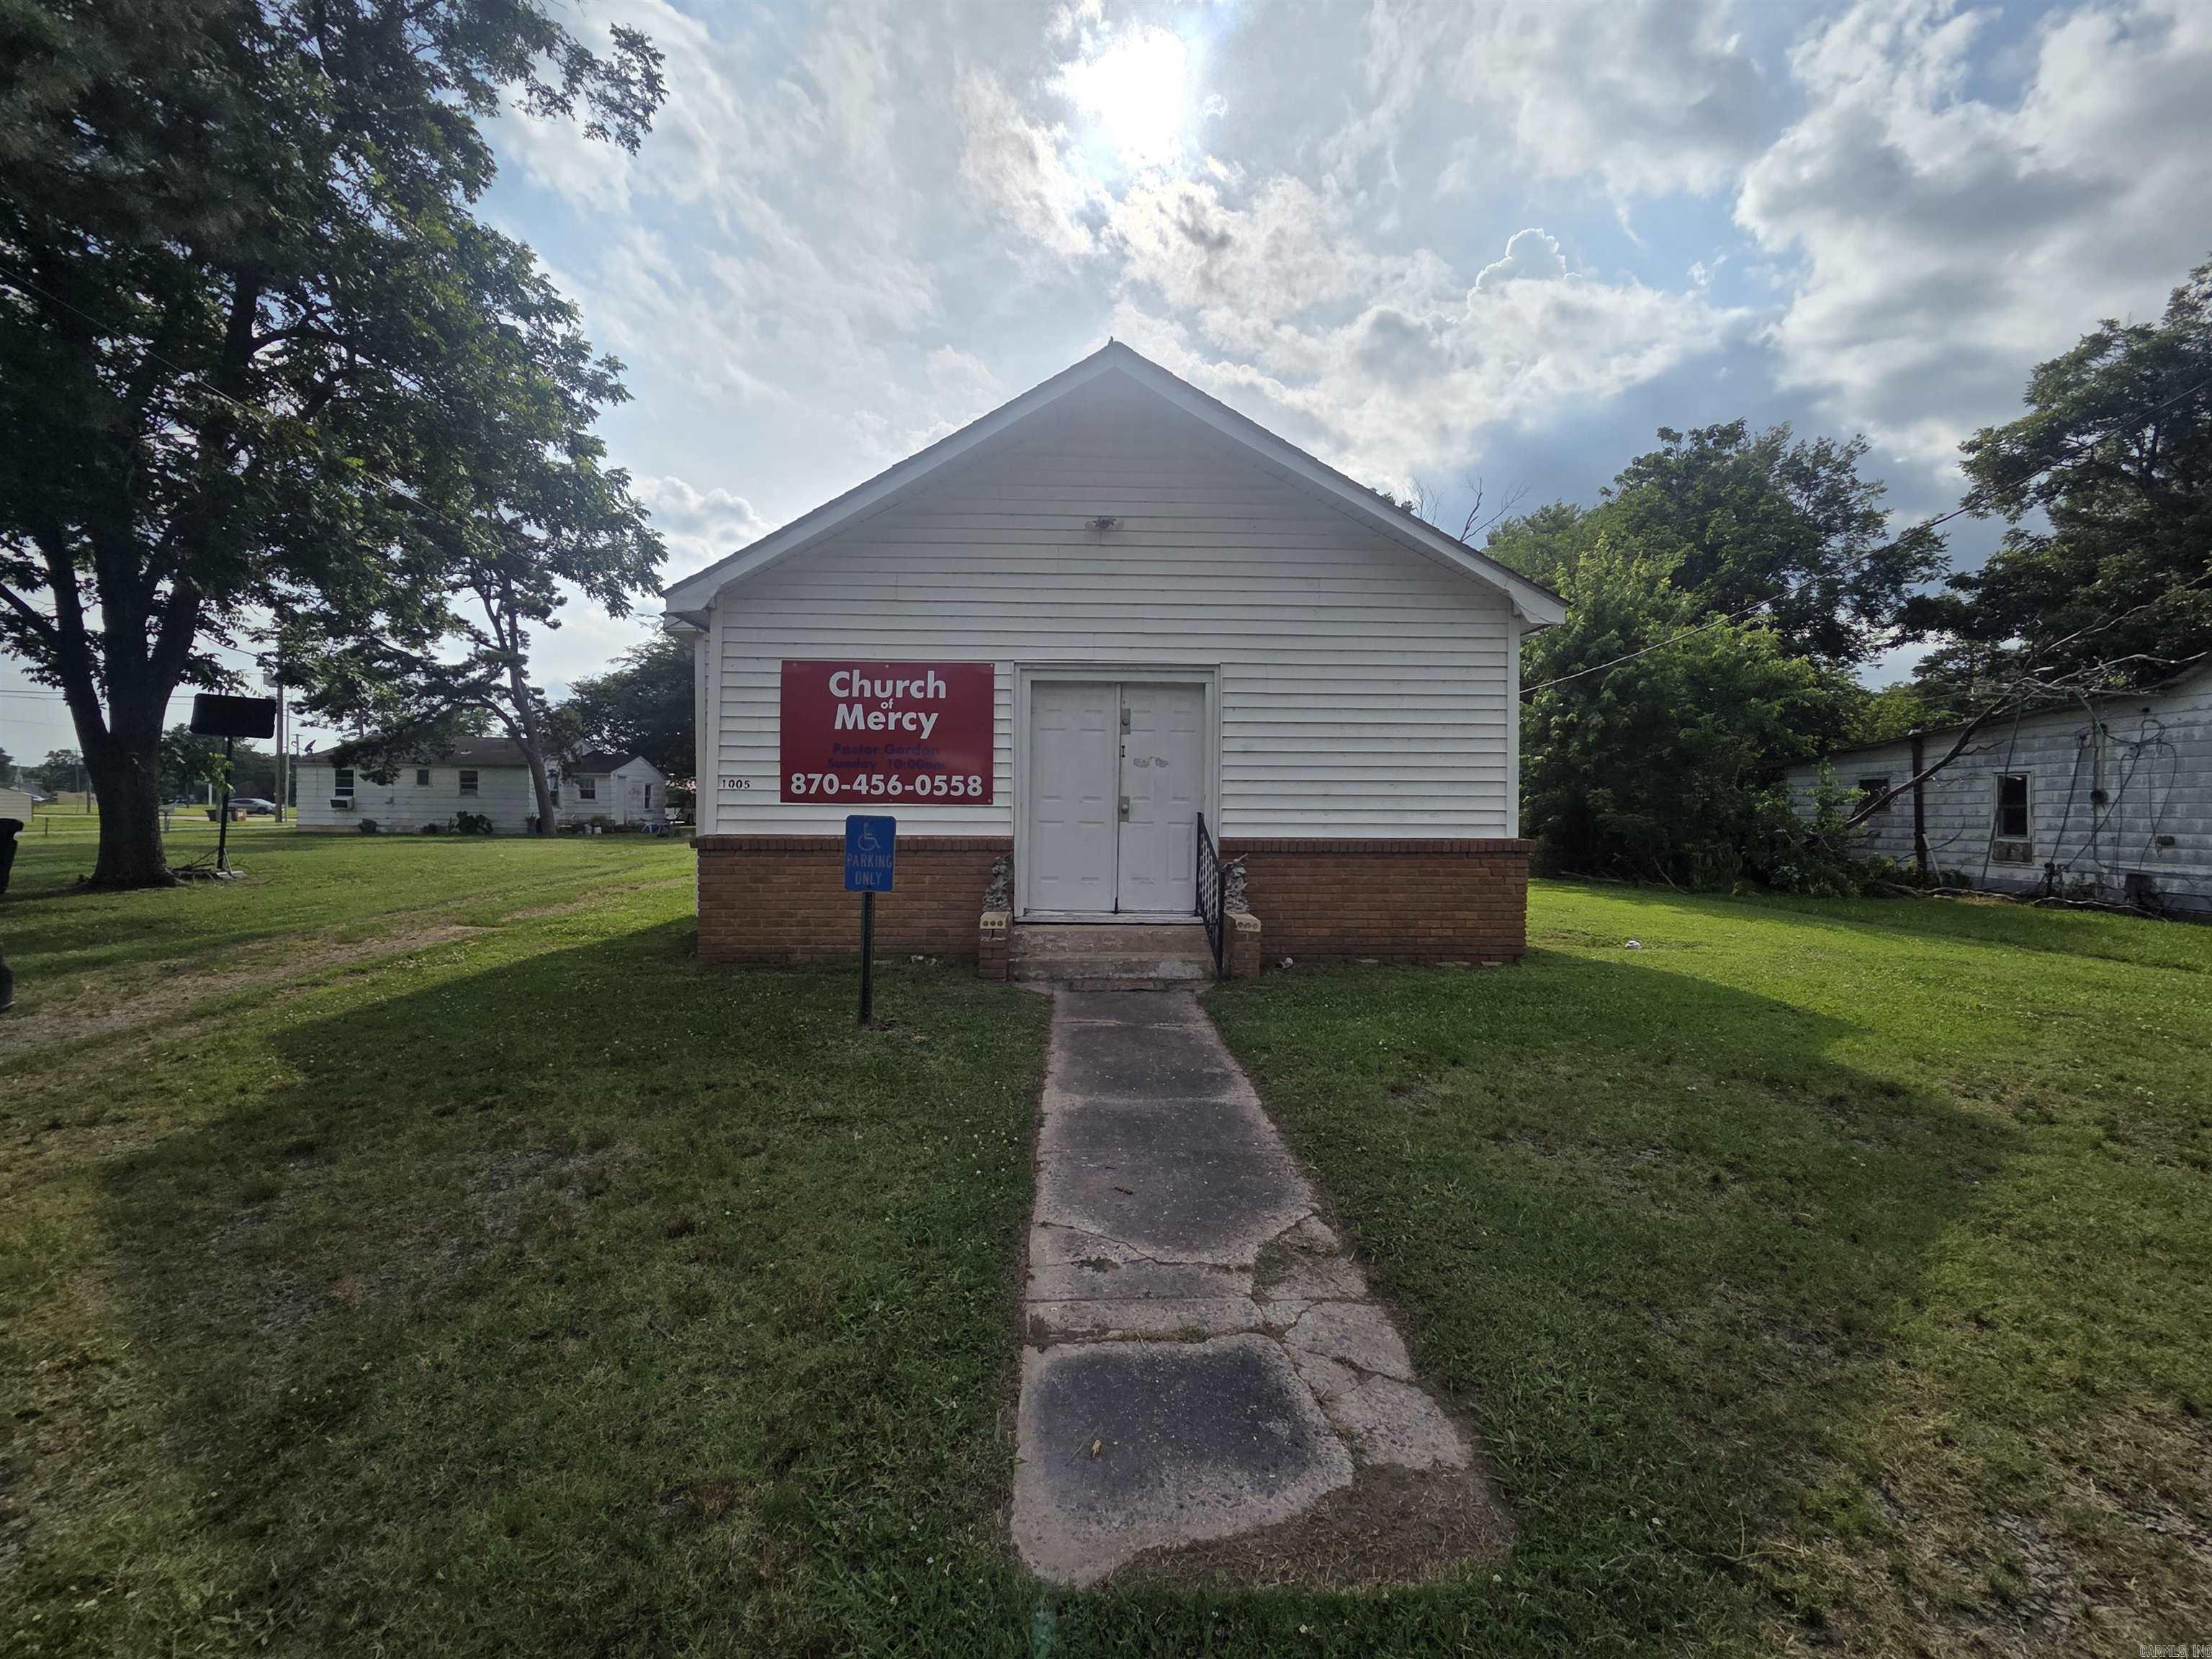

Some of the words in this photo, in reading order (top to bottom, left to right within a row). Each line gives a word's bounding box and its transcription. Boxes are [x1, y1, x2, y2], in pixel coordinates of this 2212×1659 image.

[829, 669, 946, 698] Church
[880, 698, 894, 709] of
[834, 703, 939, 739] Mercy
[832, 742, 878, 755] Pastor
[884, 742, 939, 755] Gordon
[723, 779, 750, 788] 1005
[791, 773, 983, 796] 870-456-0558
[847, 853, 892, 868] PARKING
[855, 871, 882, 886] ONLY
